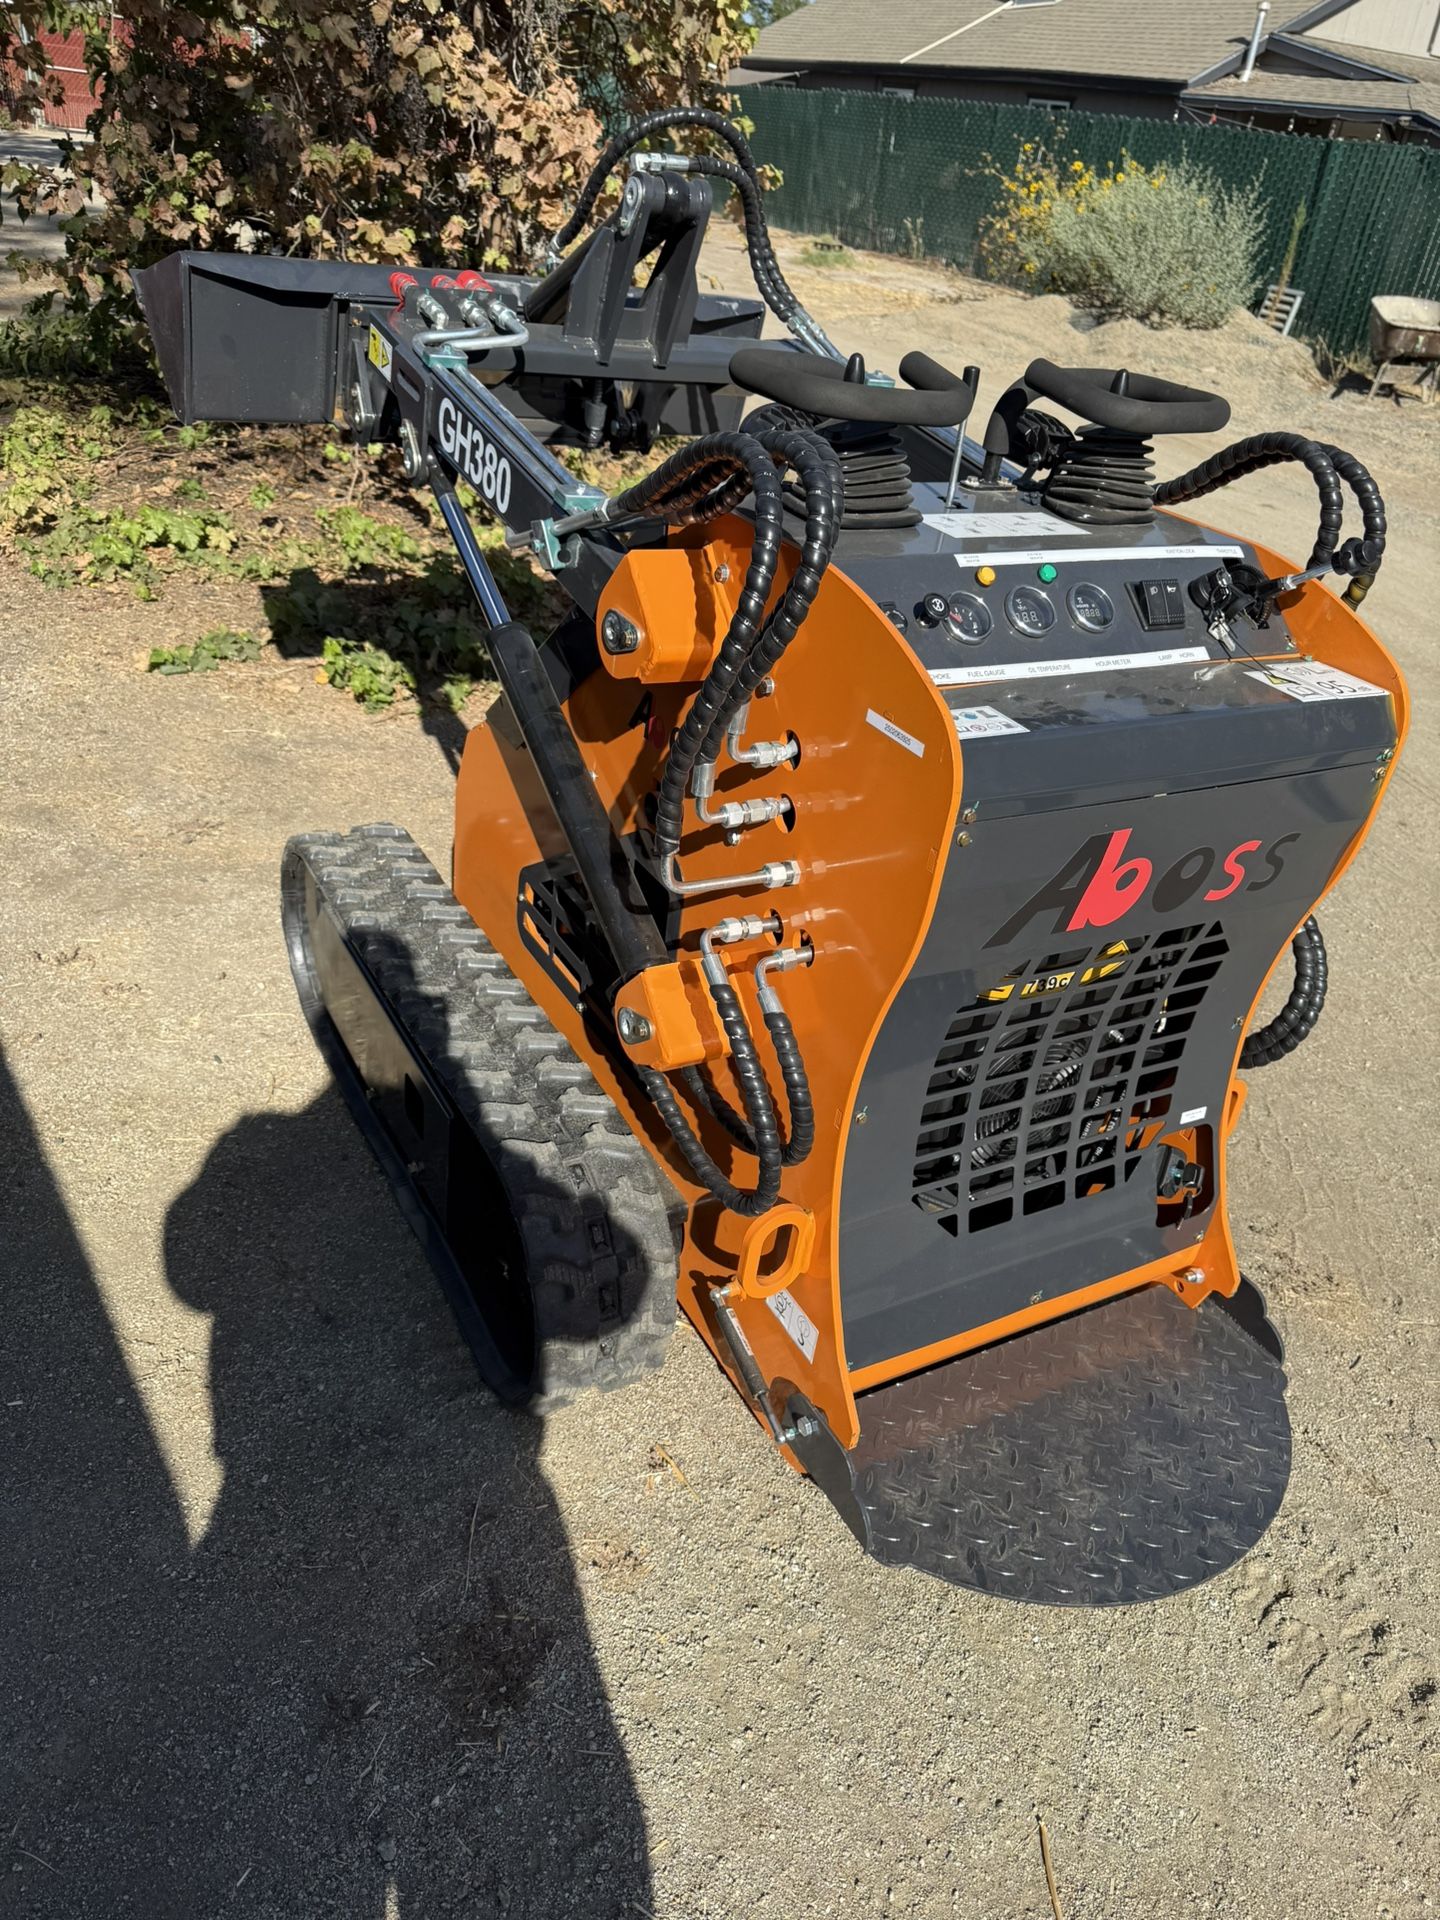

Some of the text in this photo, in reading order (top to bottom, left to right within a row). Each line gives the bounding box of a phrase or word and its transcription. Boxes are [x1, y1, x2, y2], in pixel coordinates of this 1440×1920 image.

[438, 397, 512, 514] GH380
[1095, 660, 1111, 668] HOUR
[967, 668, 1006, 678] FUEL GAUGE
